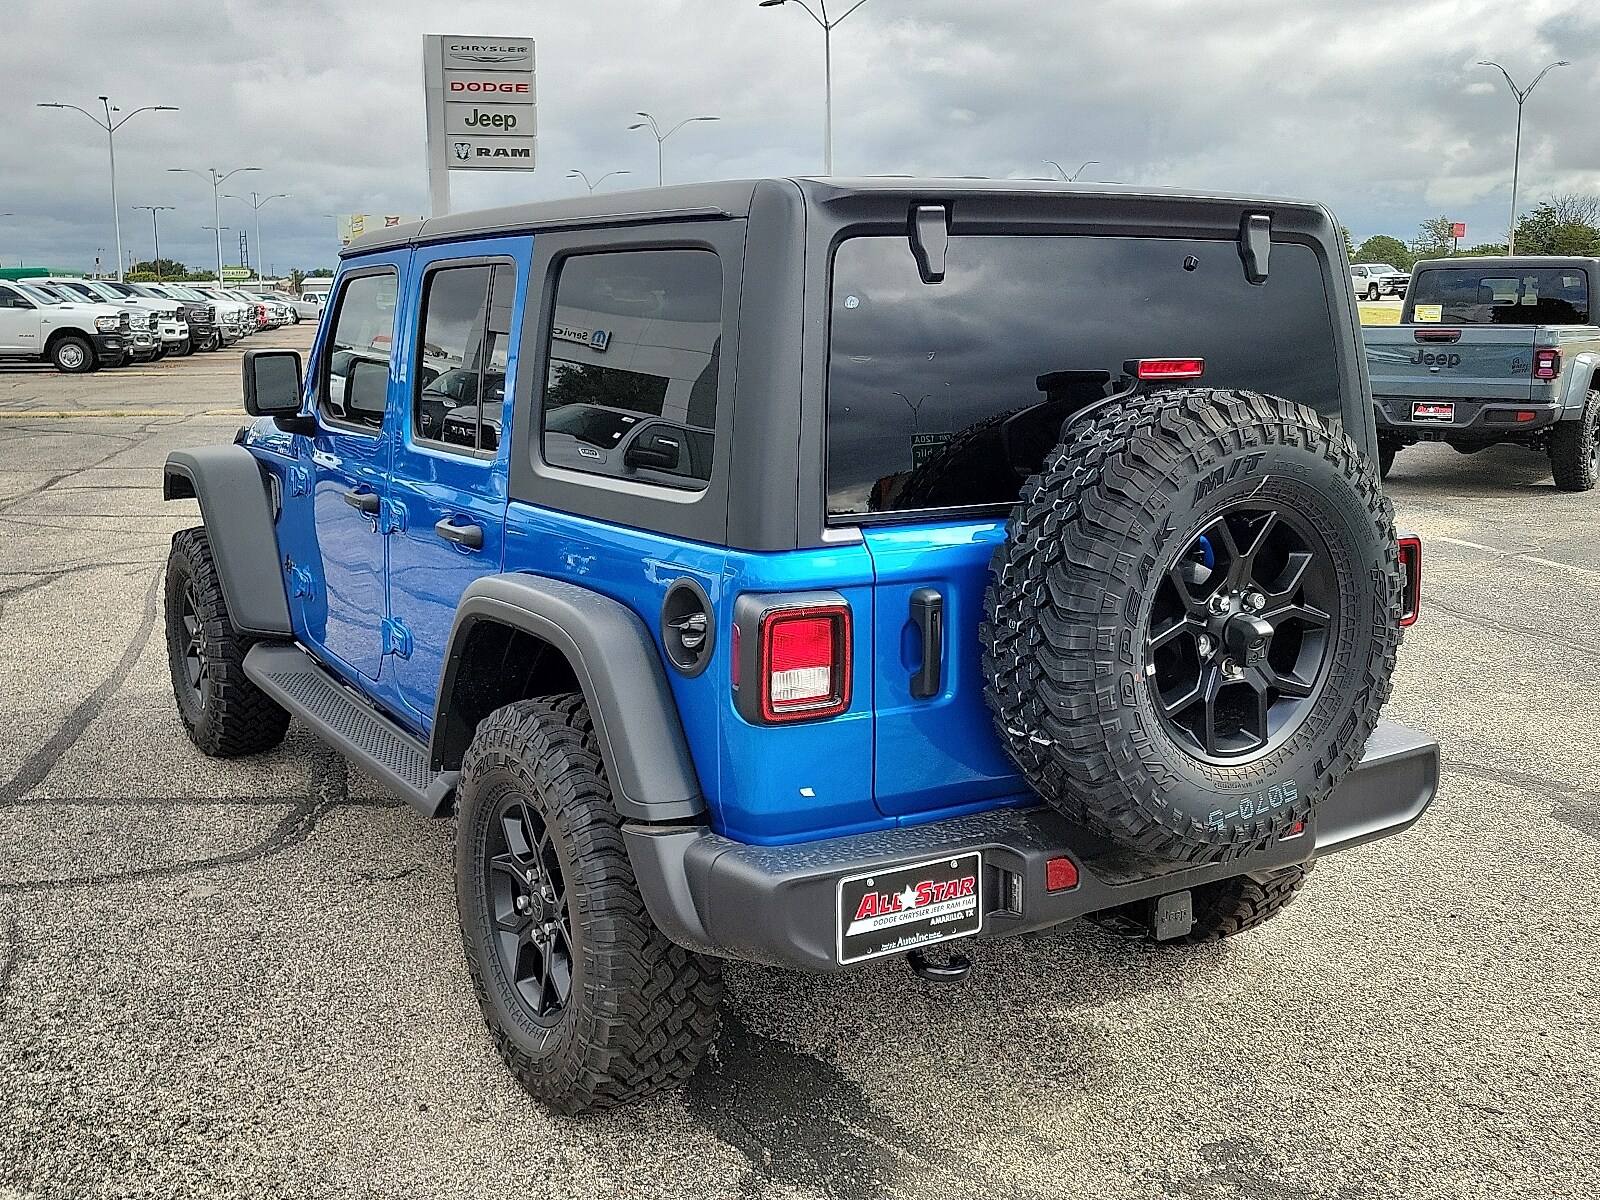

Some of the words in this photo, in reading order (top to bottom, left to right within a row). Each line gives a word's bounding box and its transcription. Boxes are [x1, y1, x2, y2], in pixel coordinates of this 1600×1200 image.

[450, 45, 527, 53] CHRYSLER
[450, 82, 529, 93] DODGE
[464, 108, 517, 131] Jeep
[476, 147, 531, 158] RAM
[1410, 349, 1461, 368] Jeep
[1193, 450, 1267, 508] M/T
[854, 891, 903, 920] ALL
[914, 876, 976, 909] STAR
[873, 915, 897, 927] DODGE
[898, 908, 930, 921] CHRYSLER
[946, 901, 961, 910] RAM
[965, 909, 975, 918] TX
